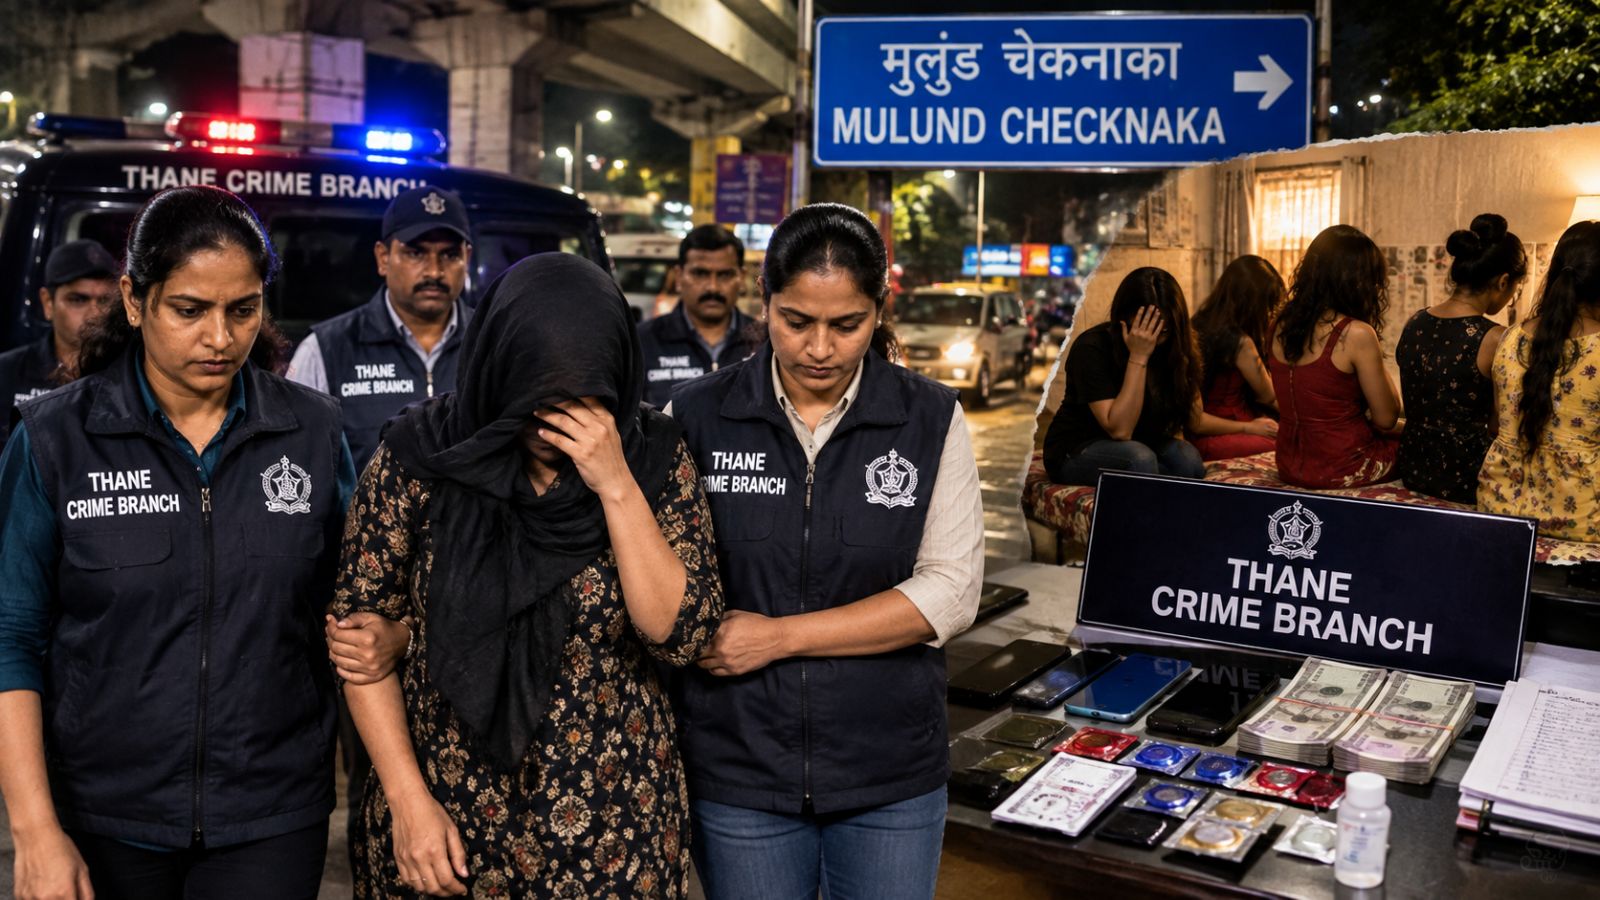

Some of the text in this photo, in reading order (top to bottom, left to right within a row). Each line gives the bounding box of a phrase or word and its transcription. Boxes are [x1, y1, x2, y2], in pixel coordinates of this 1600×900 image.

[879, 28, 1183, 97] मुलुंड चेकनाका
[832, 106, 1226, 145] MULUND CHECKNAKA
[122, 165, 217, 190] THANE
[226, 169, 312, 196] CRIME
[354, 363, 396, 380] THANE
[341, 379, 415, 397] CRIME BRANCH
[711, 451, 767, 471] THANE
[87, 469, 152, 492] THANE
[731, 475, 787, 496] BRANCH
[66, 493, 181, 520] CRIME BRANCH
[1226, 557, 1353, 604] THANE
[1150, 585, 1434, 655] CRIME BRANCH
